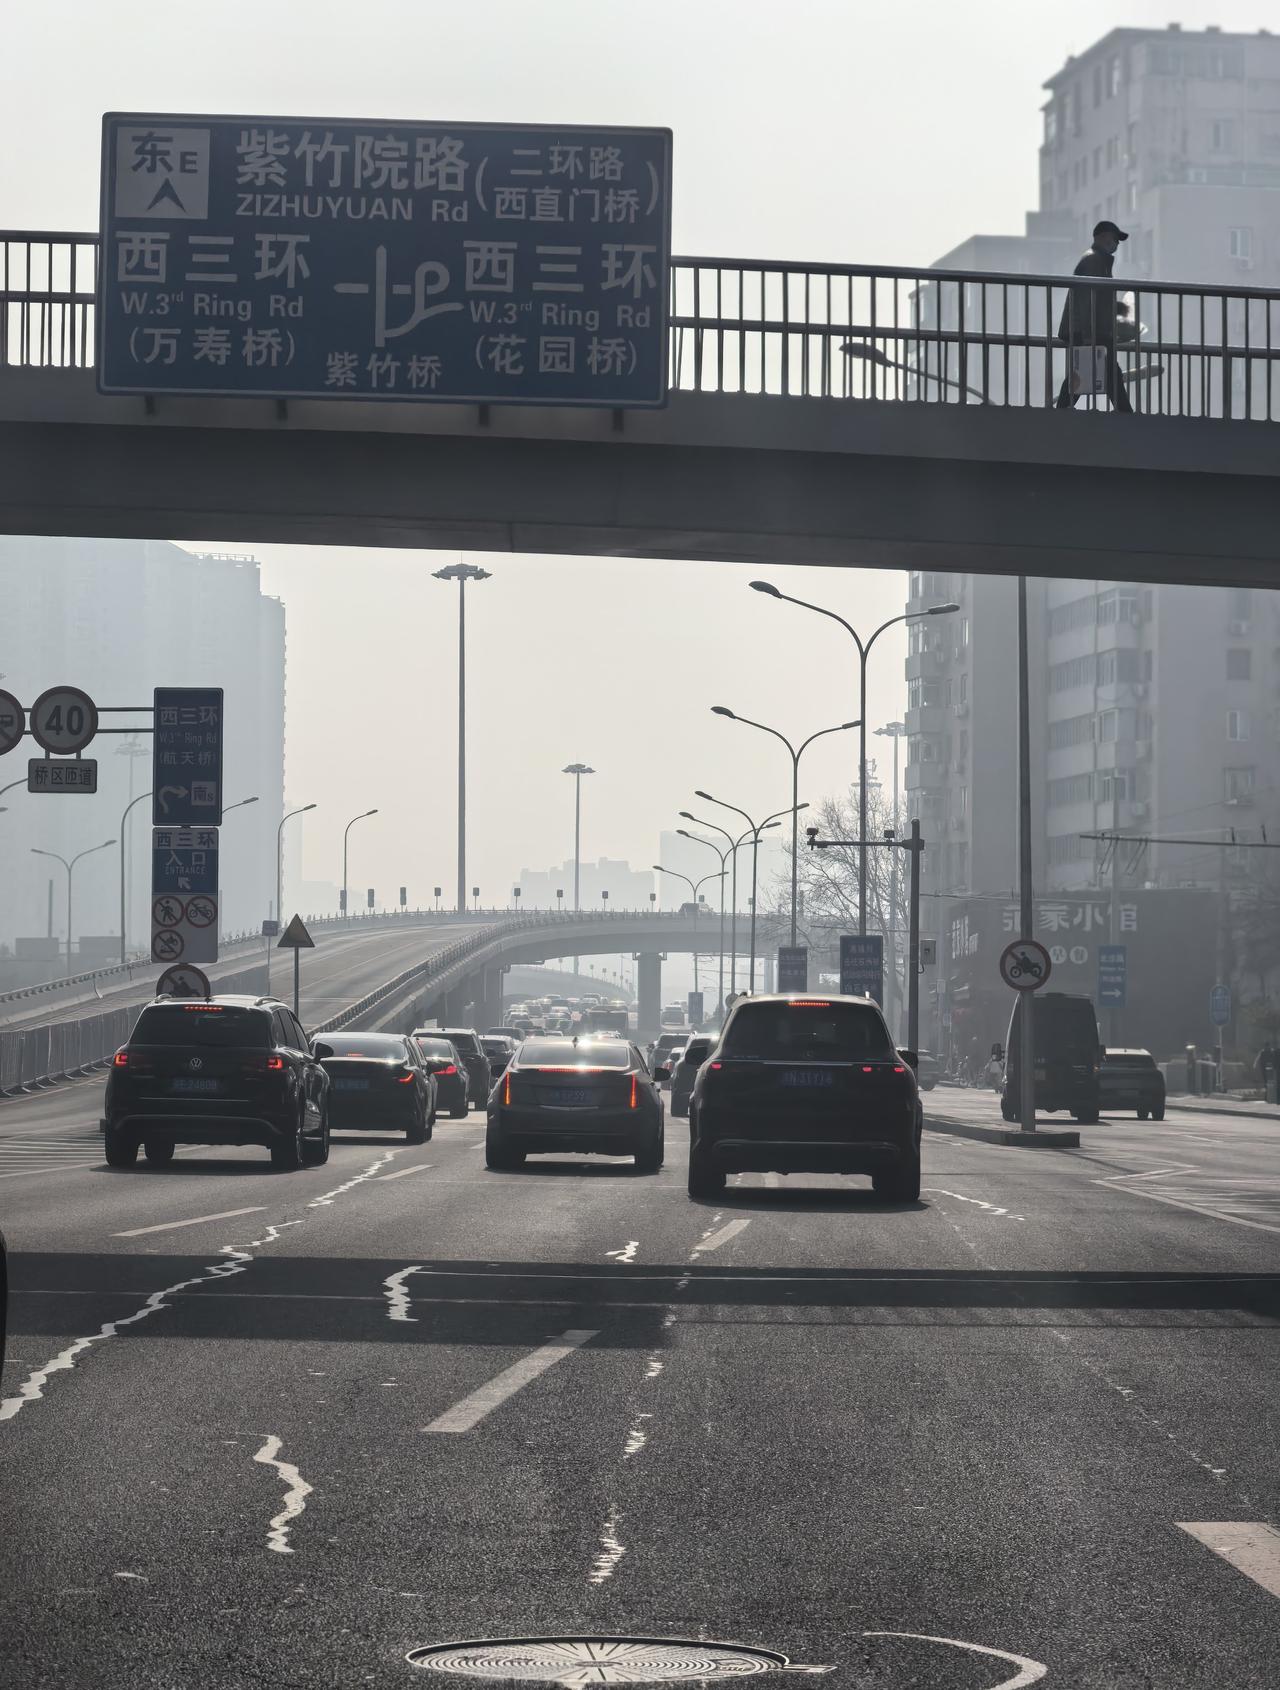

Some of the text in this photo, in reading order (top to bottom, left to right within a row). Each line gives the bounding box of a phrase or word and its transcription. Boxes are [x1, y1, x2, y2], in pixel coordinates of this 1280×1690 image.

[236, 128, 469, 192] 紫竹院路
[235, 193, 469, 222] ZIZHUYUAN Rd
[115, 230, 311, 289] 西三环
[463, 240, 657, 299] 西三环
[193, 293, 252, 321] Ring
[269, 294, 304, 317] Rd
[541, 302, 600, 331] Ring
[616, 304, 650, 328] Rd
[325, 352, 442, 389] 紫竹桥
[45, 705, 84, 736] 40
[159, 705, 218, 727] 西三环
[35, 766, 93, 786] 桥区匝道
[156, 831, 215, 848] 西三环
[164, 866, 207, 876] ENTRANCE
[165, 850, 206, 866] 入口
